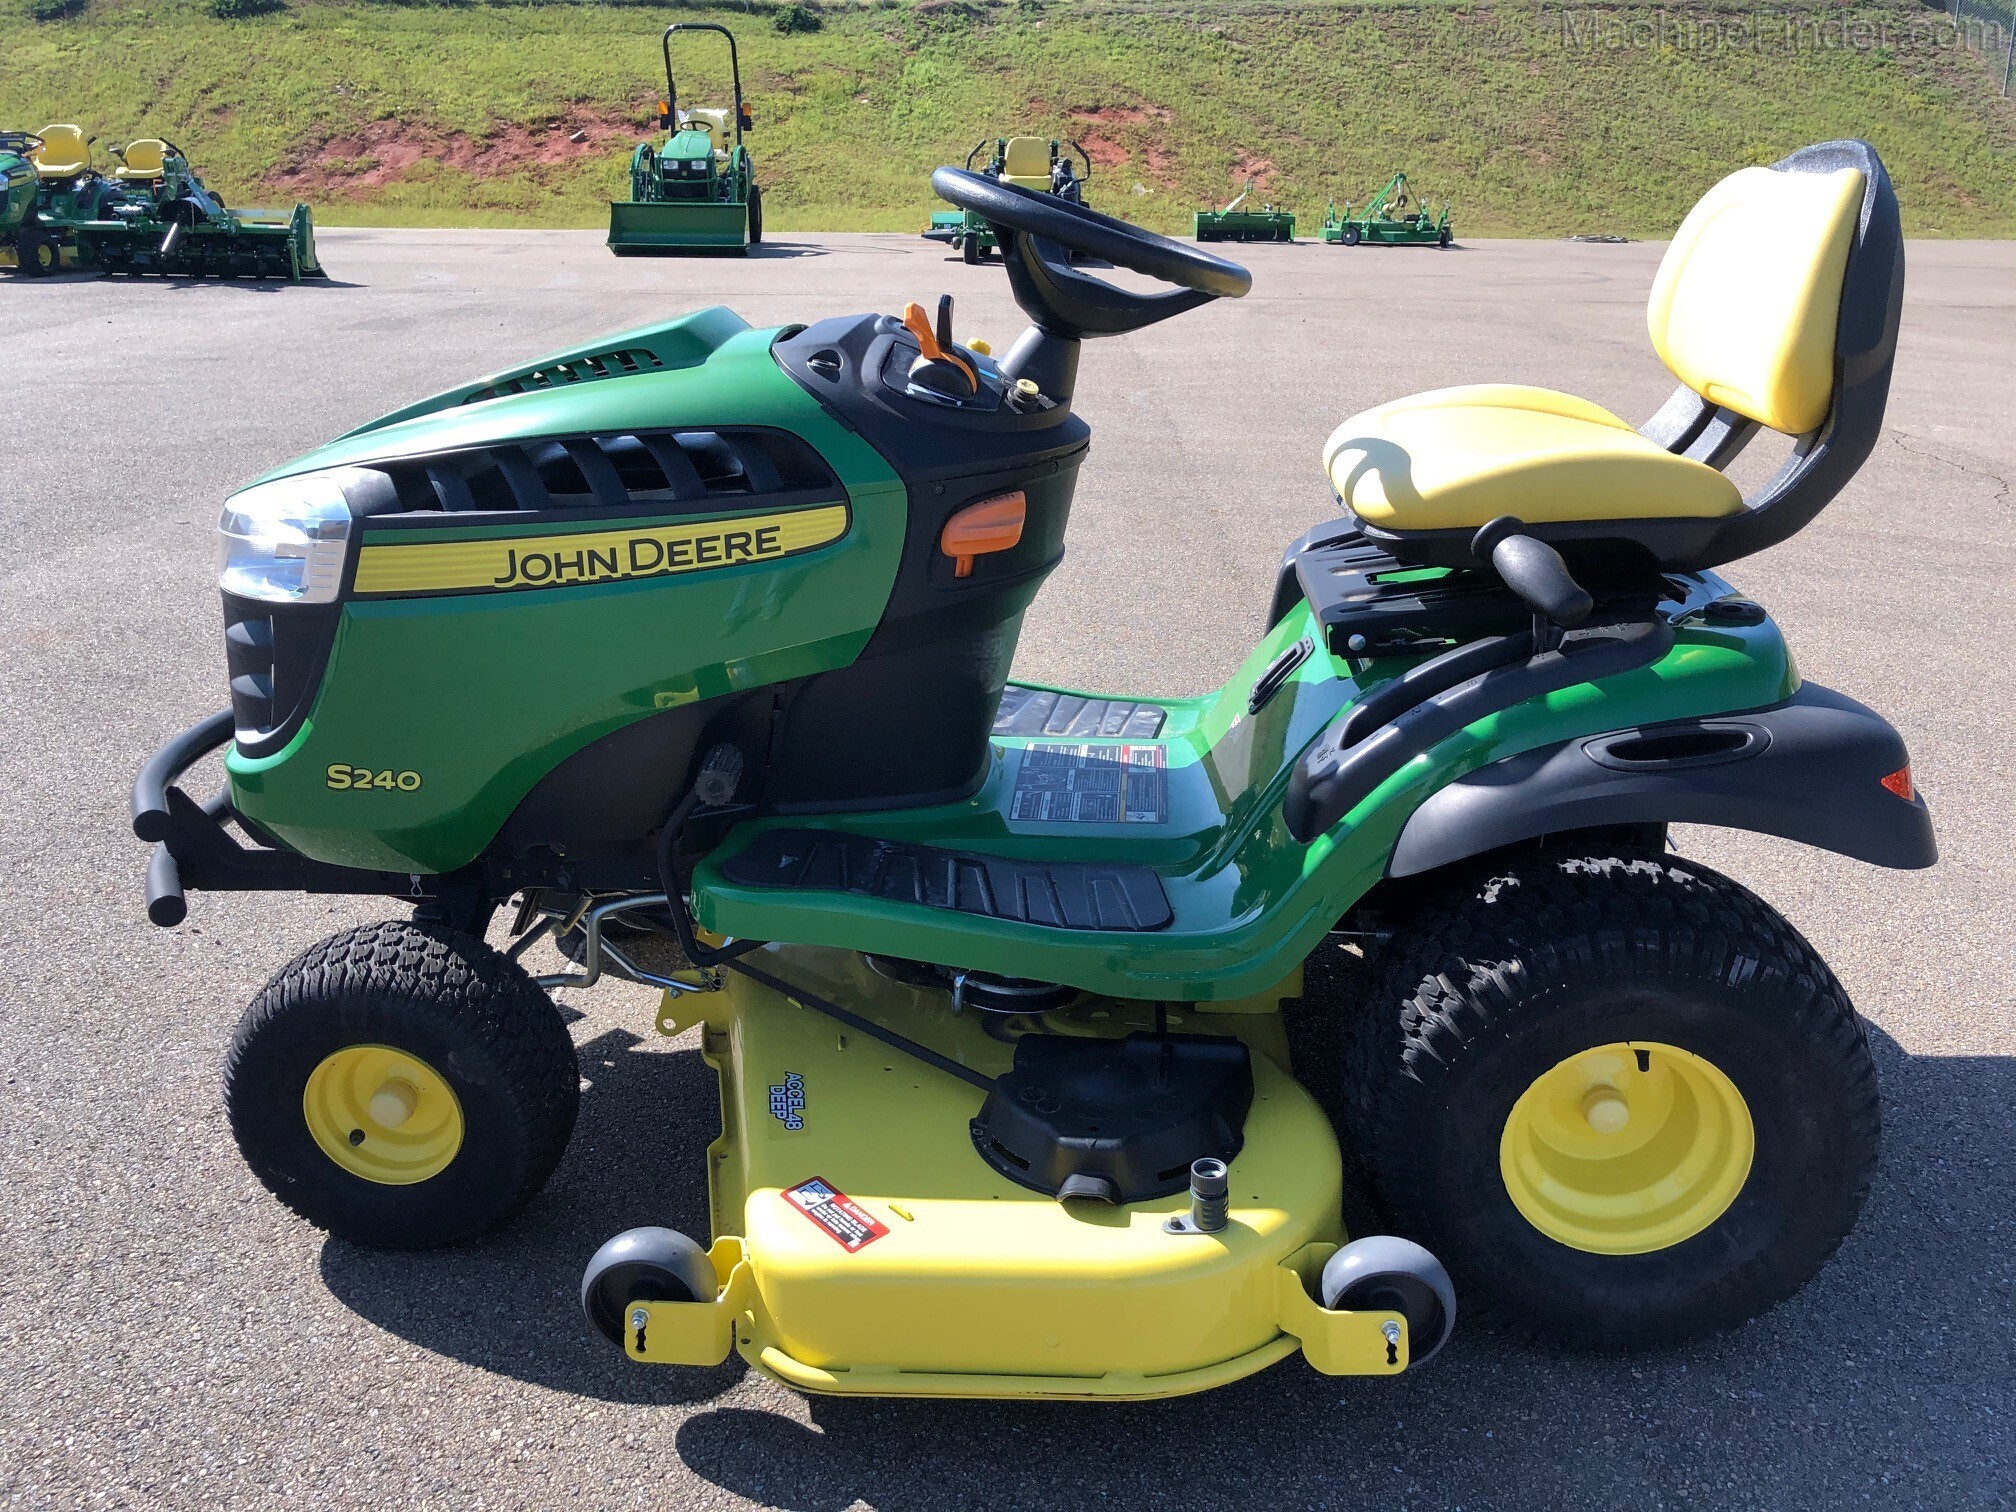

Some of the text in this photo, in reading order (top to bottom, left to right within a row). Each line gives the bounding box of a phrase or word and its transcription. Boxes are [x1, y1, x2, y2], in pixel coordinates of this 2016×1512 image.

[494, 525, 782, 584] JOHN DEERE
[326, 763, 421, 791] S240
[769, 1085, 788, 1120] DEEP
[848, 1205, 876, 1226] DANGER
